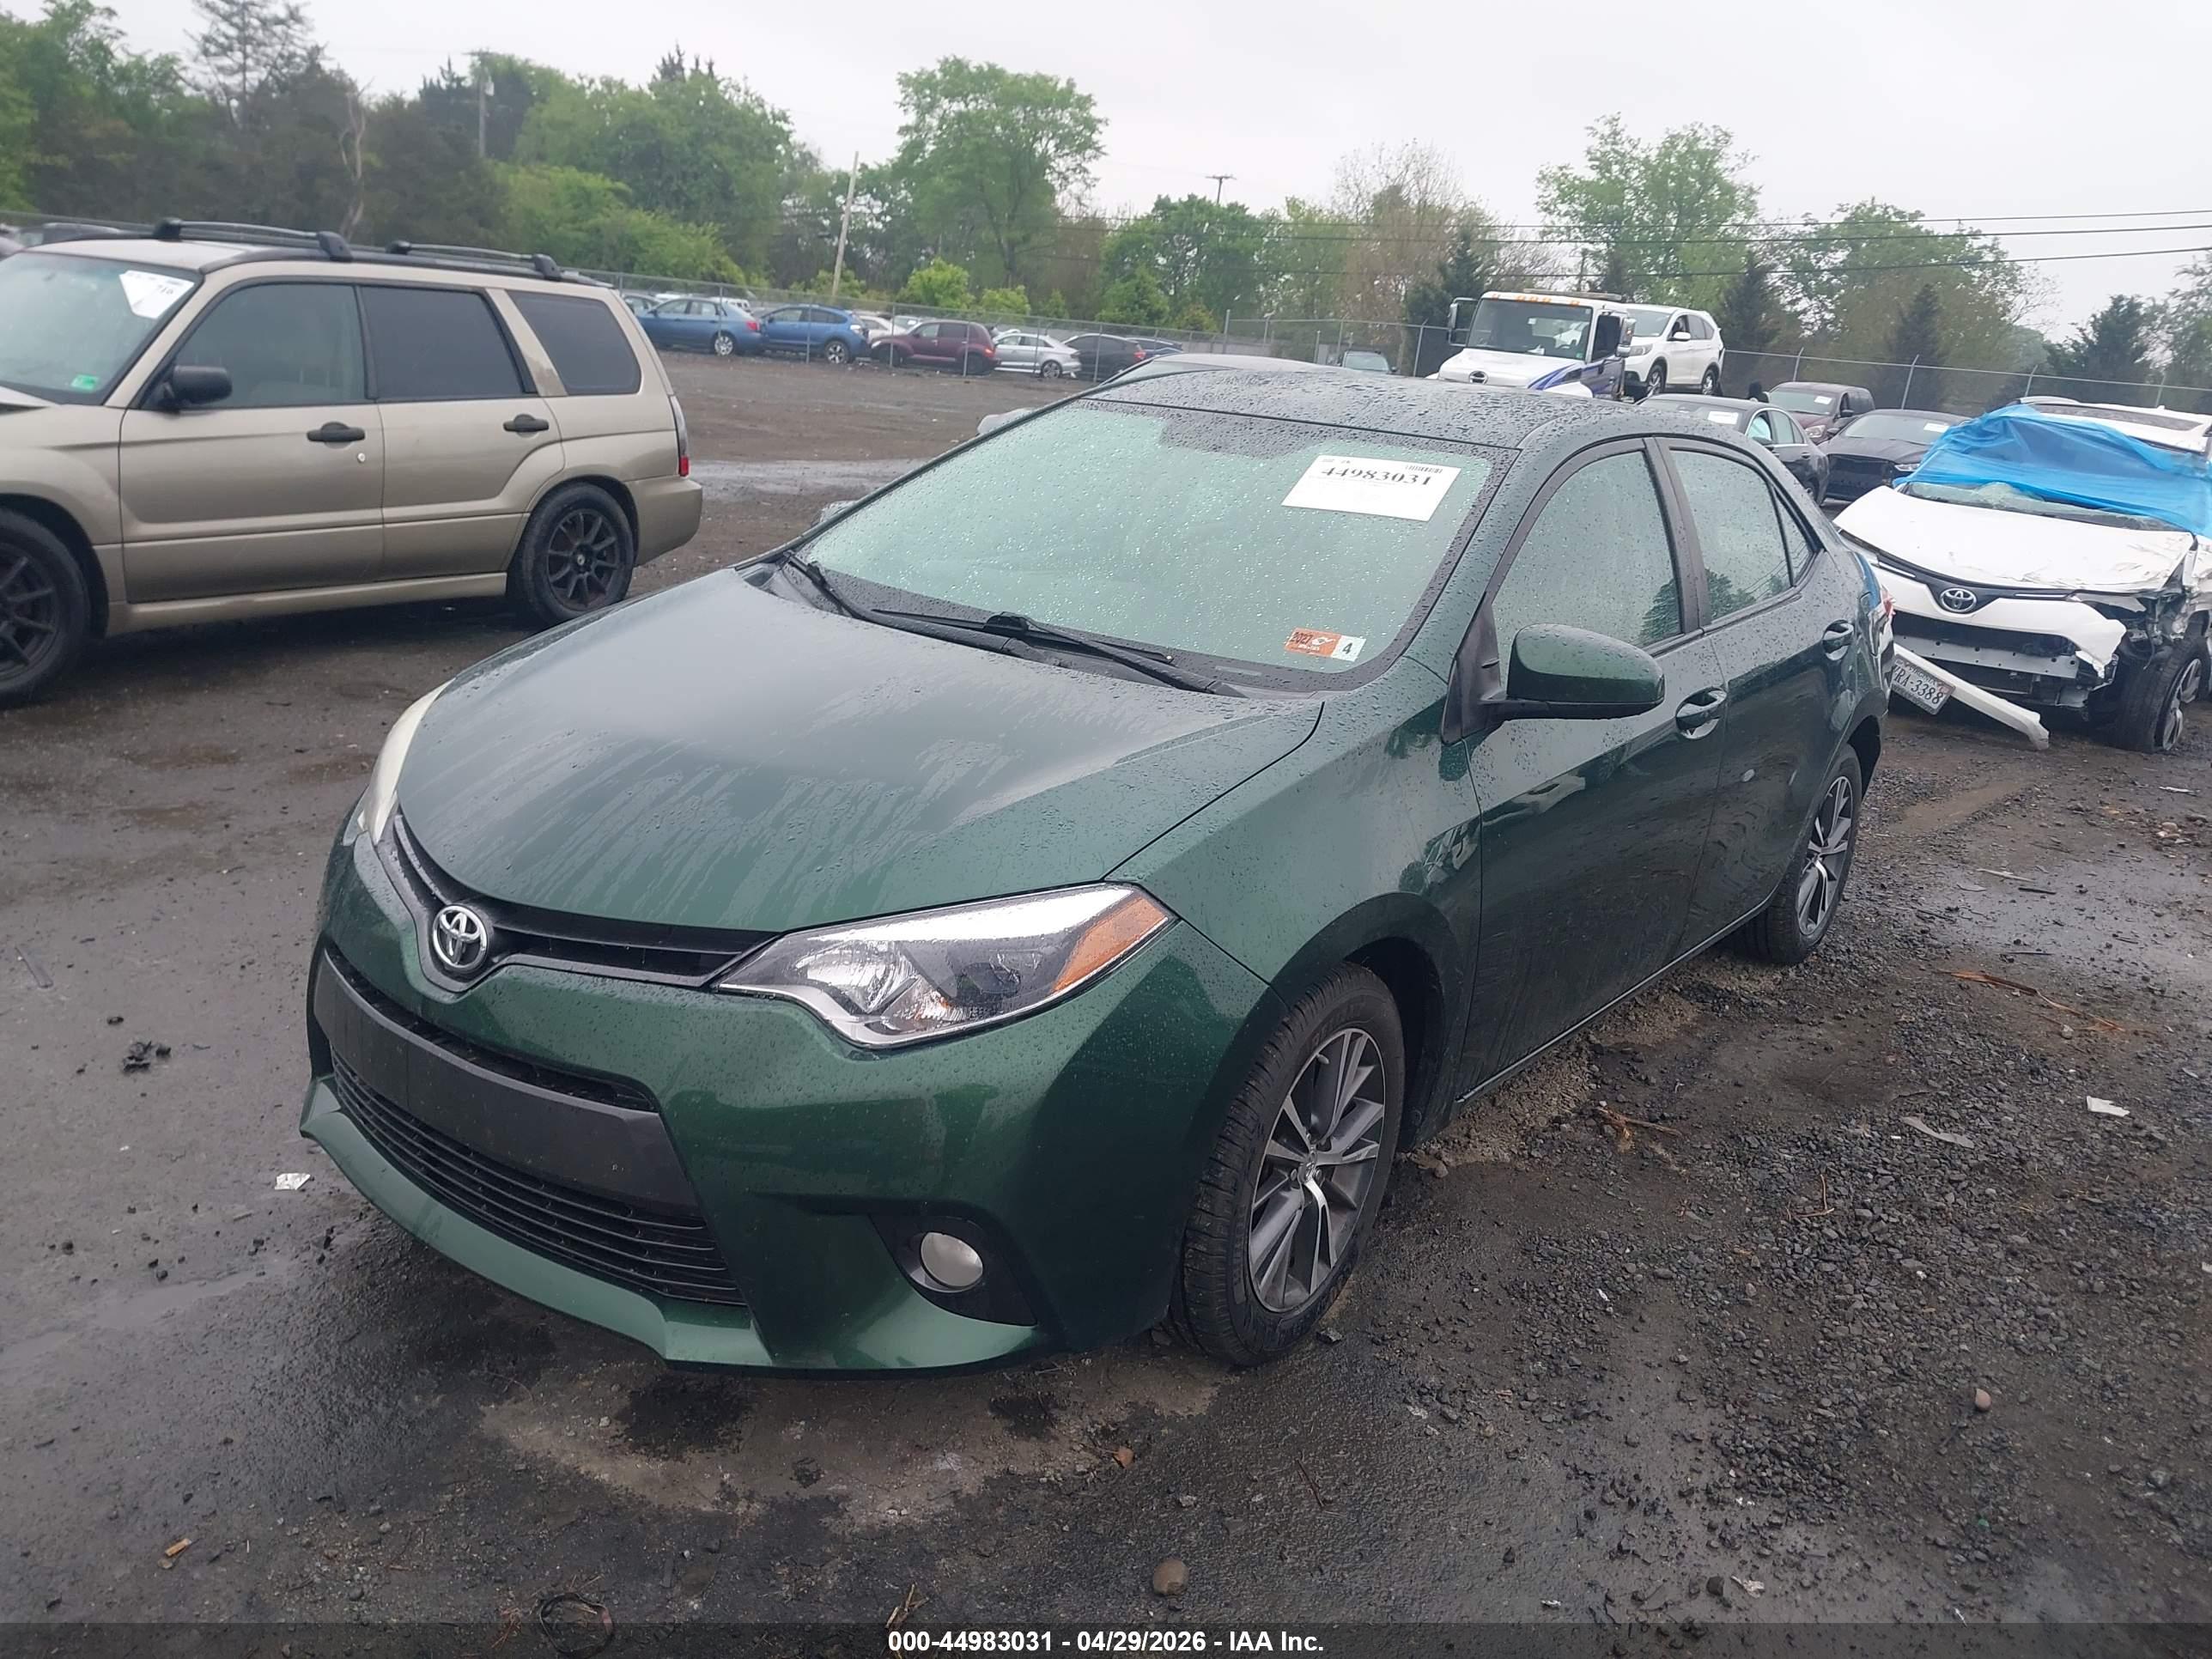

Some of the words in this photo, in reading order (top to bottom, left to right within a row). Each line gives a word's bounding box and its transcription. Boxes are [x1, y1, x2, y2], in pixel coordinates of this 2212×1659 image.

[1321, 466, 1432, 486] 44983031
[1289, 631, 1314, 645] 2027
[1341, 642, 1353, 654] 4
